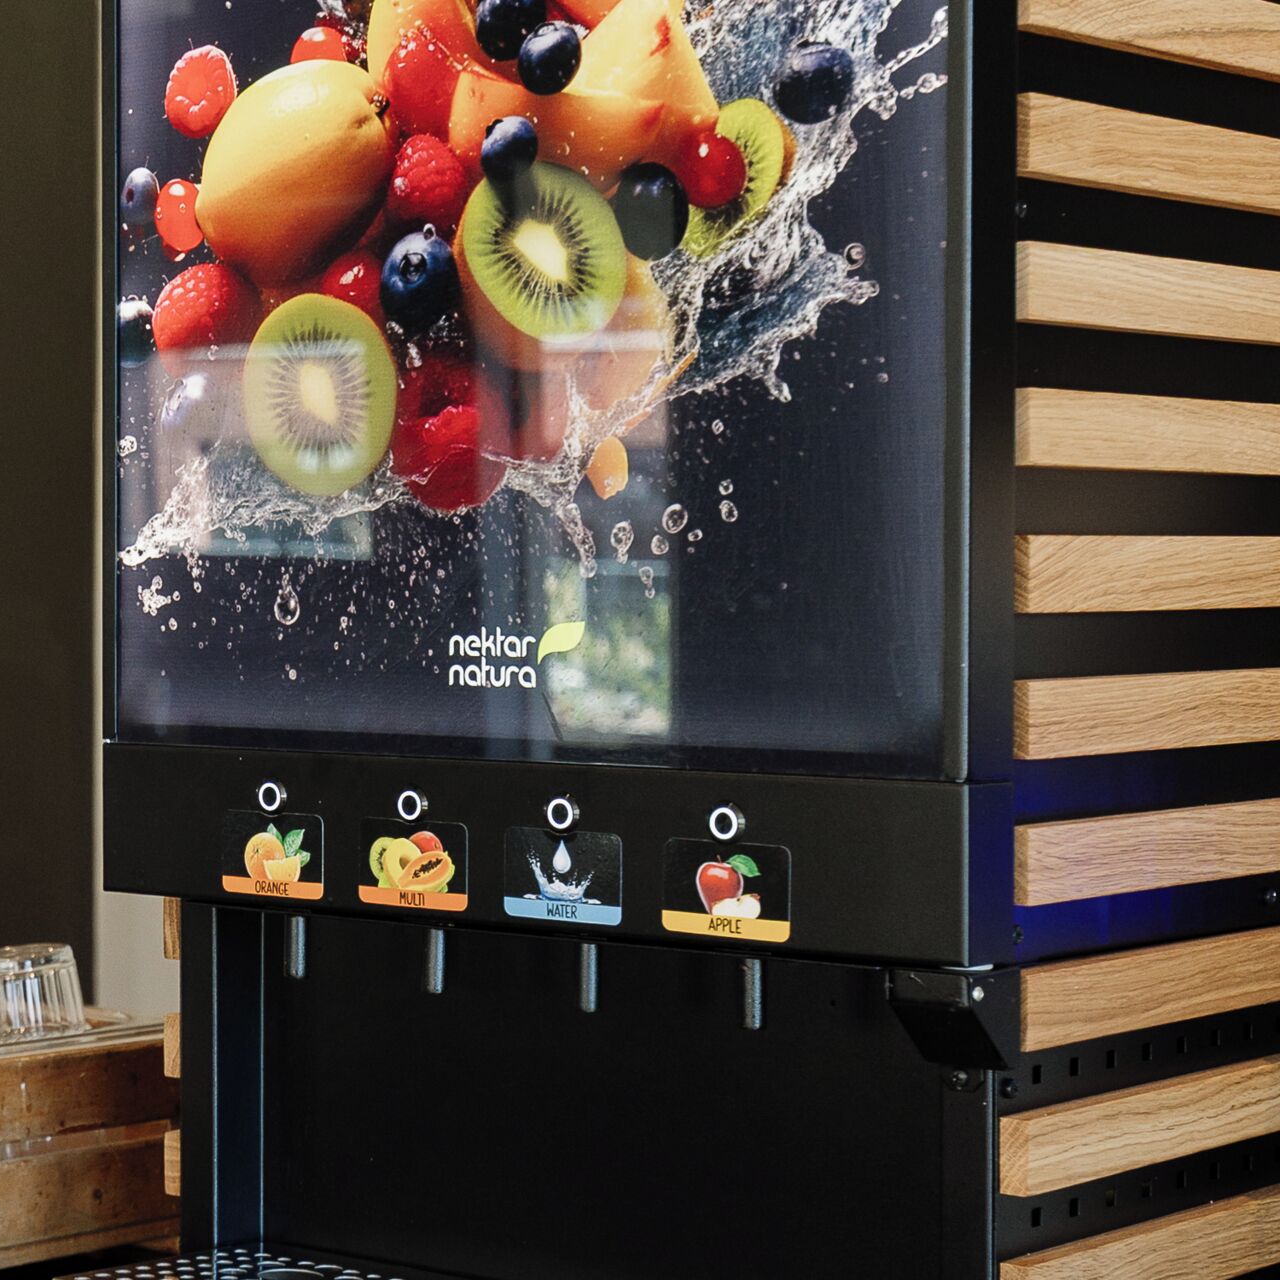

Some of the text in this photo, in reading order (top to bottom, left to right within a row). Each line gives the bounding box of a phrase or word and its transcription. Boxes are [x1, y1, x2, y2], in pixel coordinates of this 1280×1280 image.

[448, 626, 537, 658] nektar
[448, 656, 537, 689] natura
[254, 880, 289, 896] ORANGE
[399, 891, 425, 906] MULTI
[546, 903, 578, 919] WATER
[708, 918, 742, 934] APPLE
